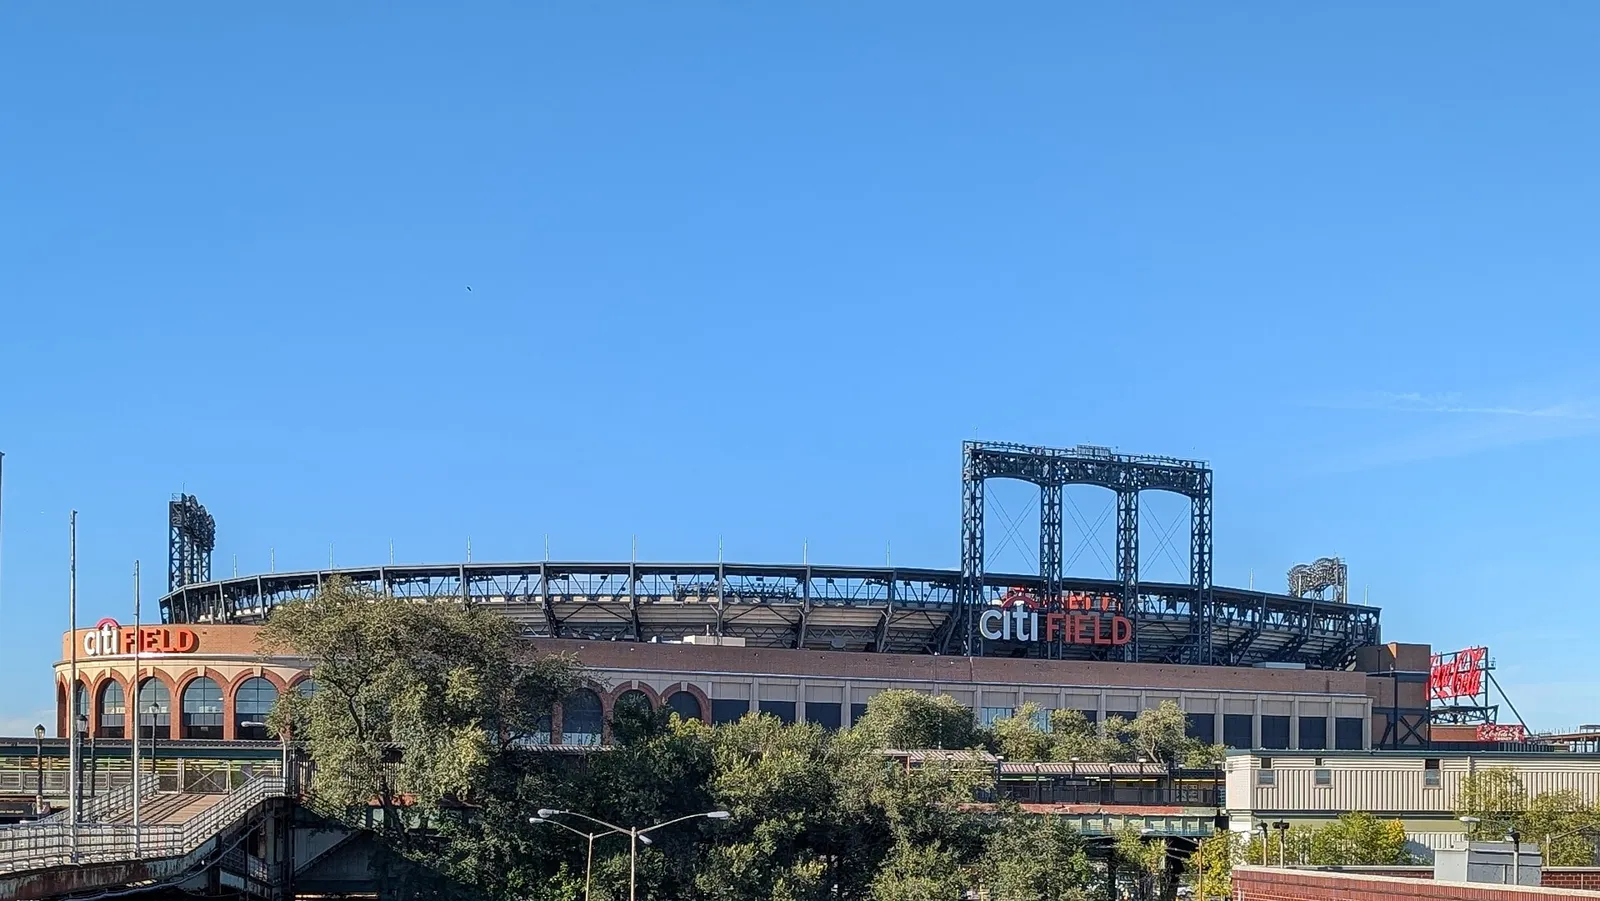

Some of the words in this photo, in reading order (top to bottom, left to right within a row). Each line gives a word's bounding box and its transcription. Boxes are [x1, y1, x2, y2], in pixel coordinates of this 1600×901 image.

[84, 623, 118, 655] citi
[980, 600, 1038, 641] citi
[1046, 612, 1132, 644] FIELD
